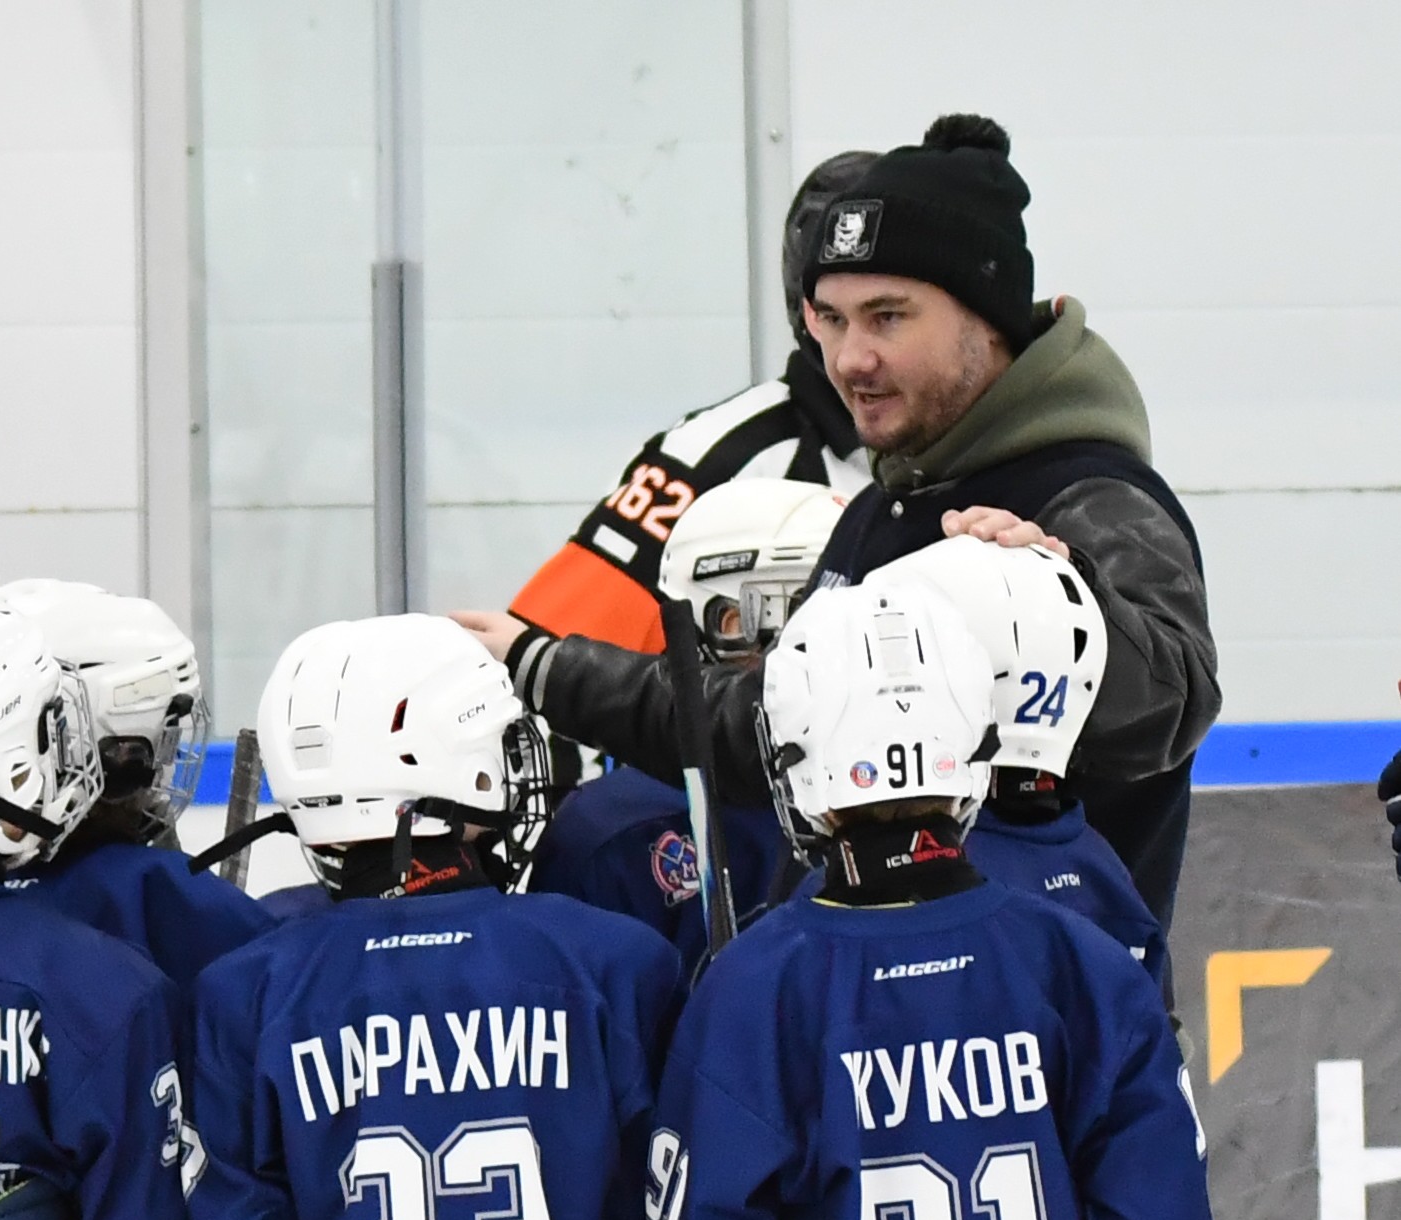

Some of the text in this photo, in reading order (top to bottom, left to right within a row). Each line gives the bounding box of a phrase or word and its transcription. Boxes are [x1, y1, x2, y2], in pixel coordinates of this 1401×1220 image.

[458, 703, 486, 724] CCM
[1014, 671, 1069, 727] 24
[886, 742, 924, 788] 91
[290, 1006, 569, 1123] ПАРАХИН
